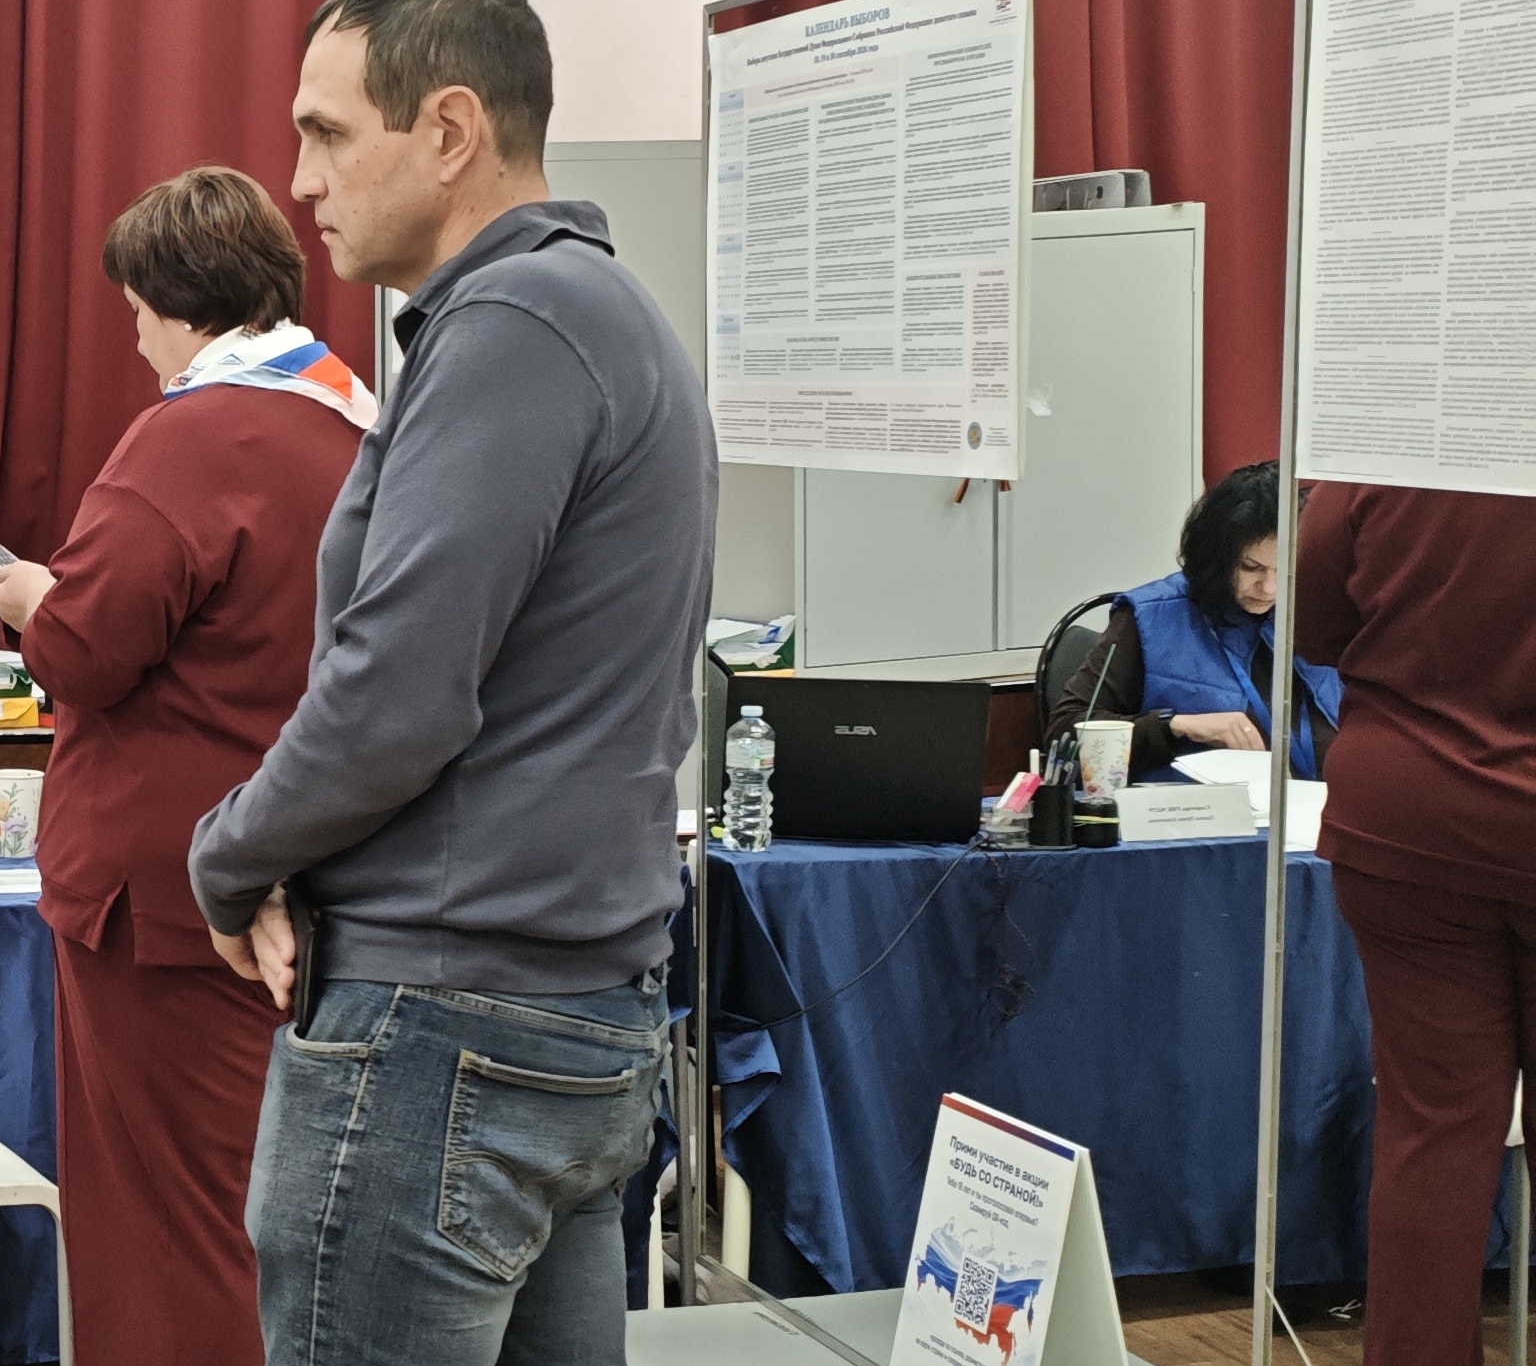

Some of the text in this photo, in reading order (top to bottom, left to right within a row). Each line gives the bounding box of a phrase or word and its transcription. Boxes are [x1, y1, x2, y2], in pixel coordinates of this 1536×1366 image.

[805, 7, 890, 37] КАЛЕНДАРЬ ВЫБОРОВ
[949, 1135, 1050, 1191] Прими участие в акции
[949, 1157, 1044, 1208] «БУДЬ СО СТРАНОЙ!»
